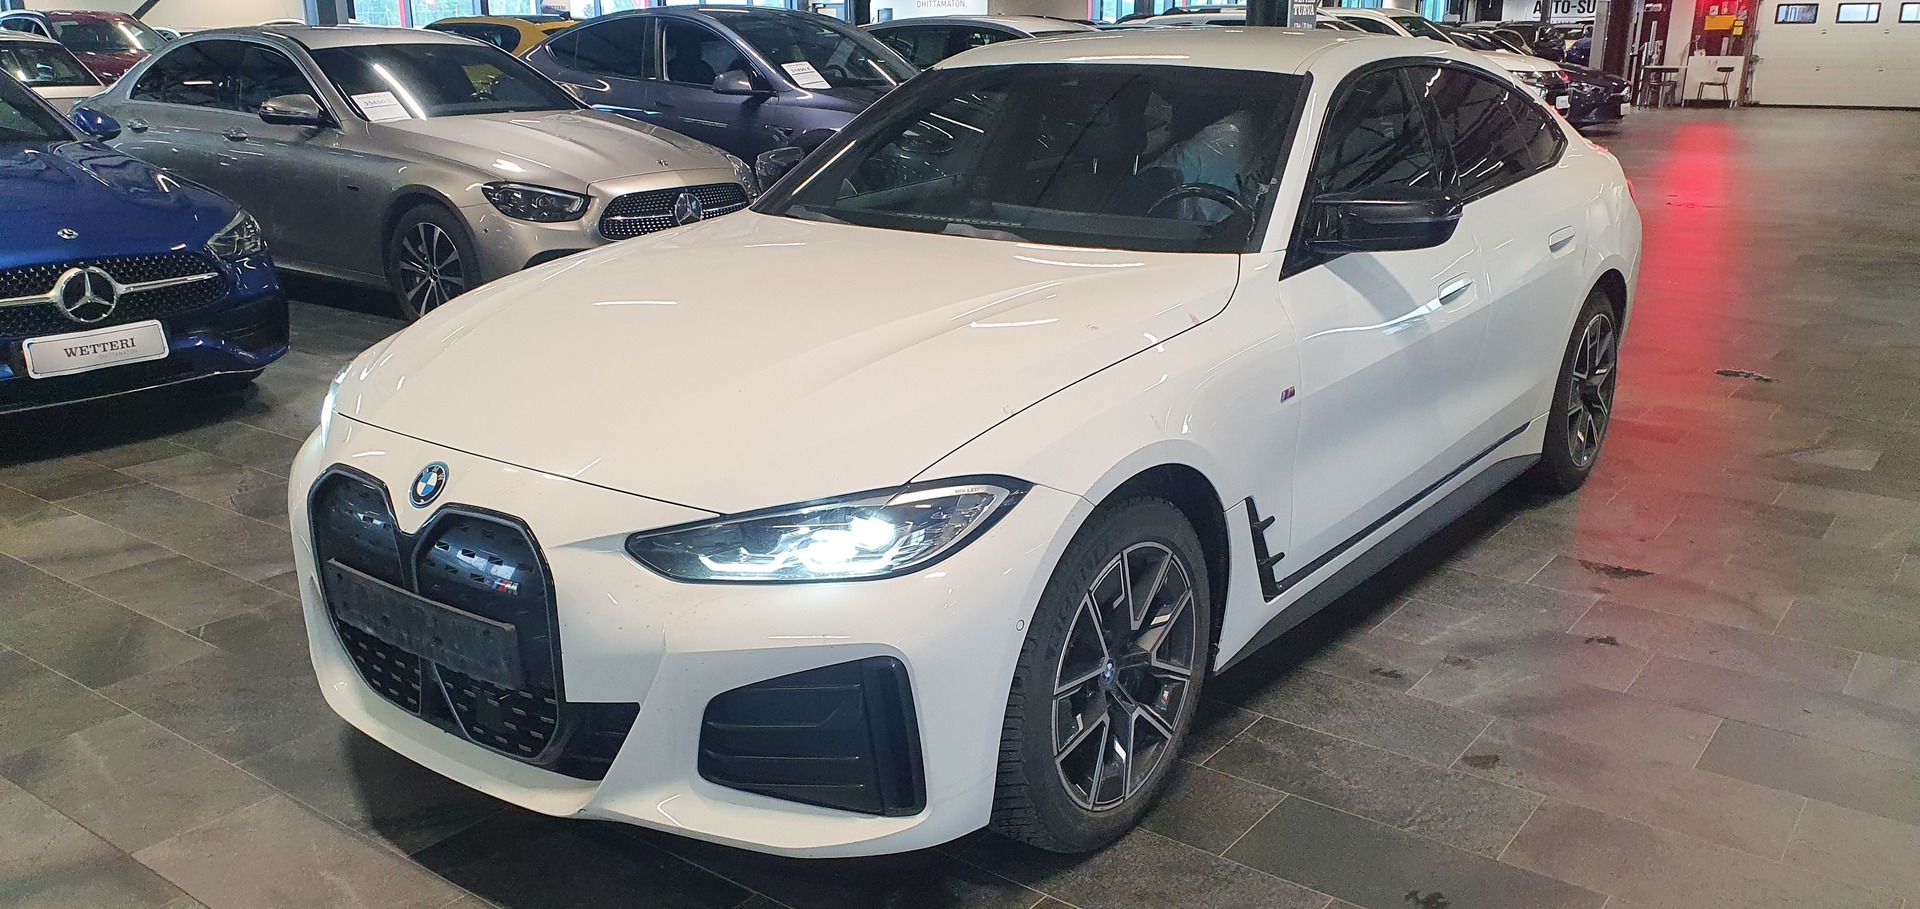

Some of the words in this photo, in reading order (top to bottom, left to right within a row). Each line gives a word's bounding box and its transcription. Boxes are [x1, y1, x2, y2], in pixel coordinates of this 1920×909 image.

[1293, 4, 1315, 16] TURVA
[1533, 0, 1595, 14] ATO-SU
[63, 337, 137, 359] WETTERI
